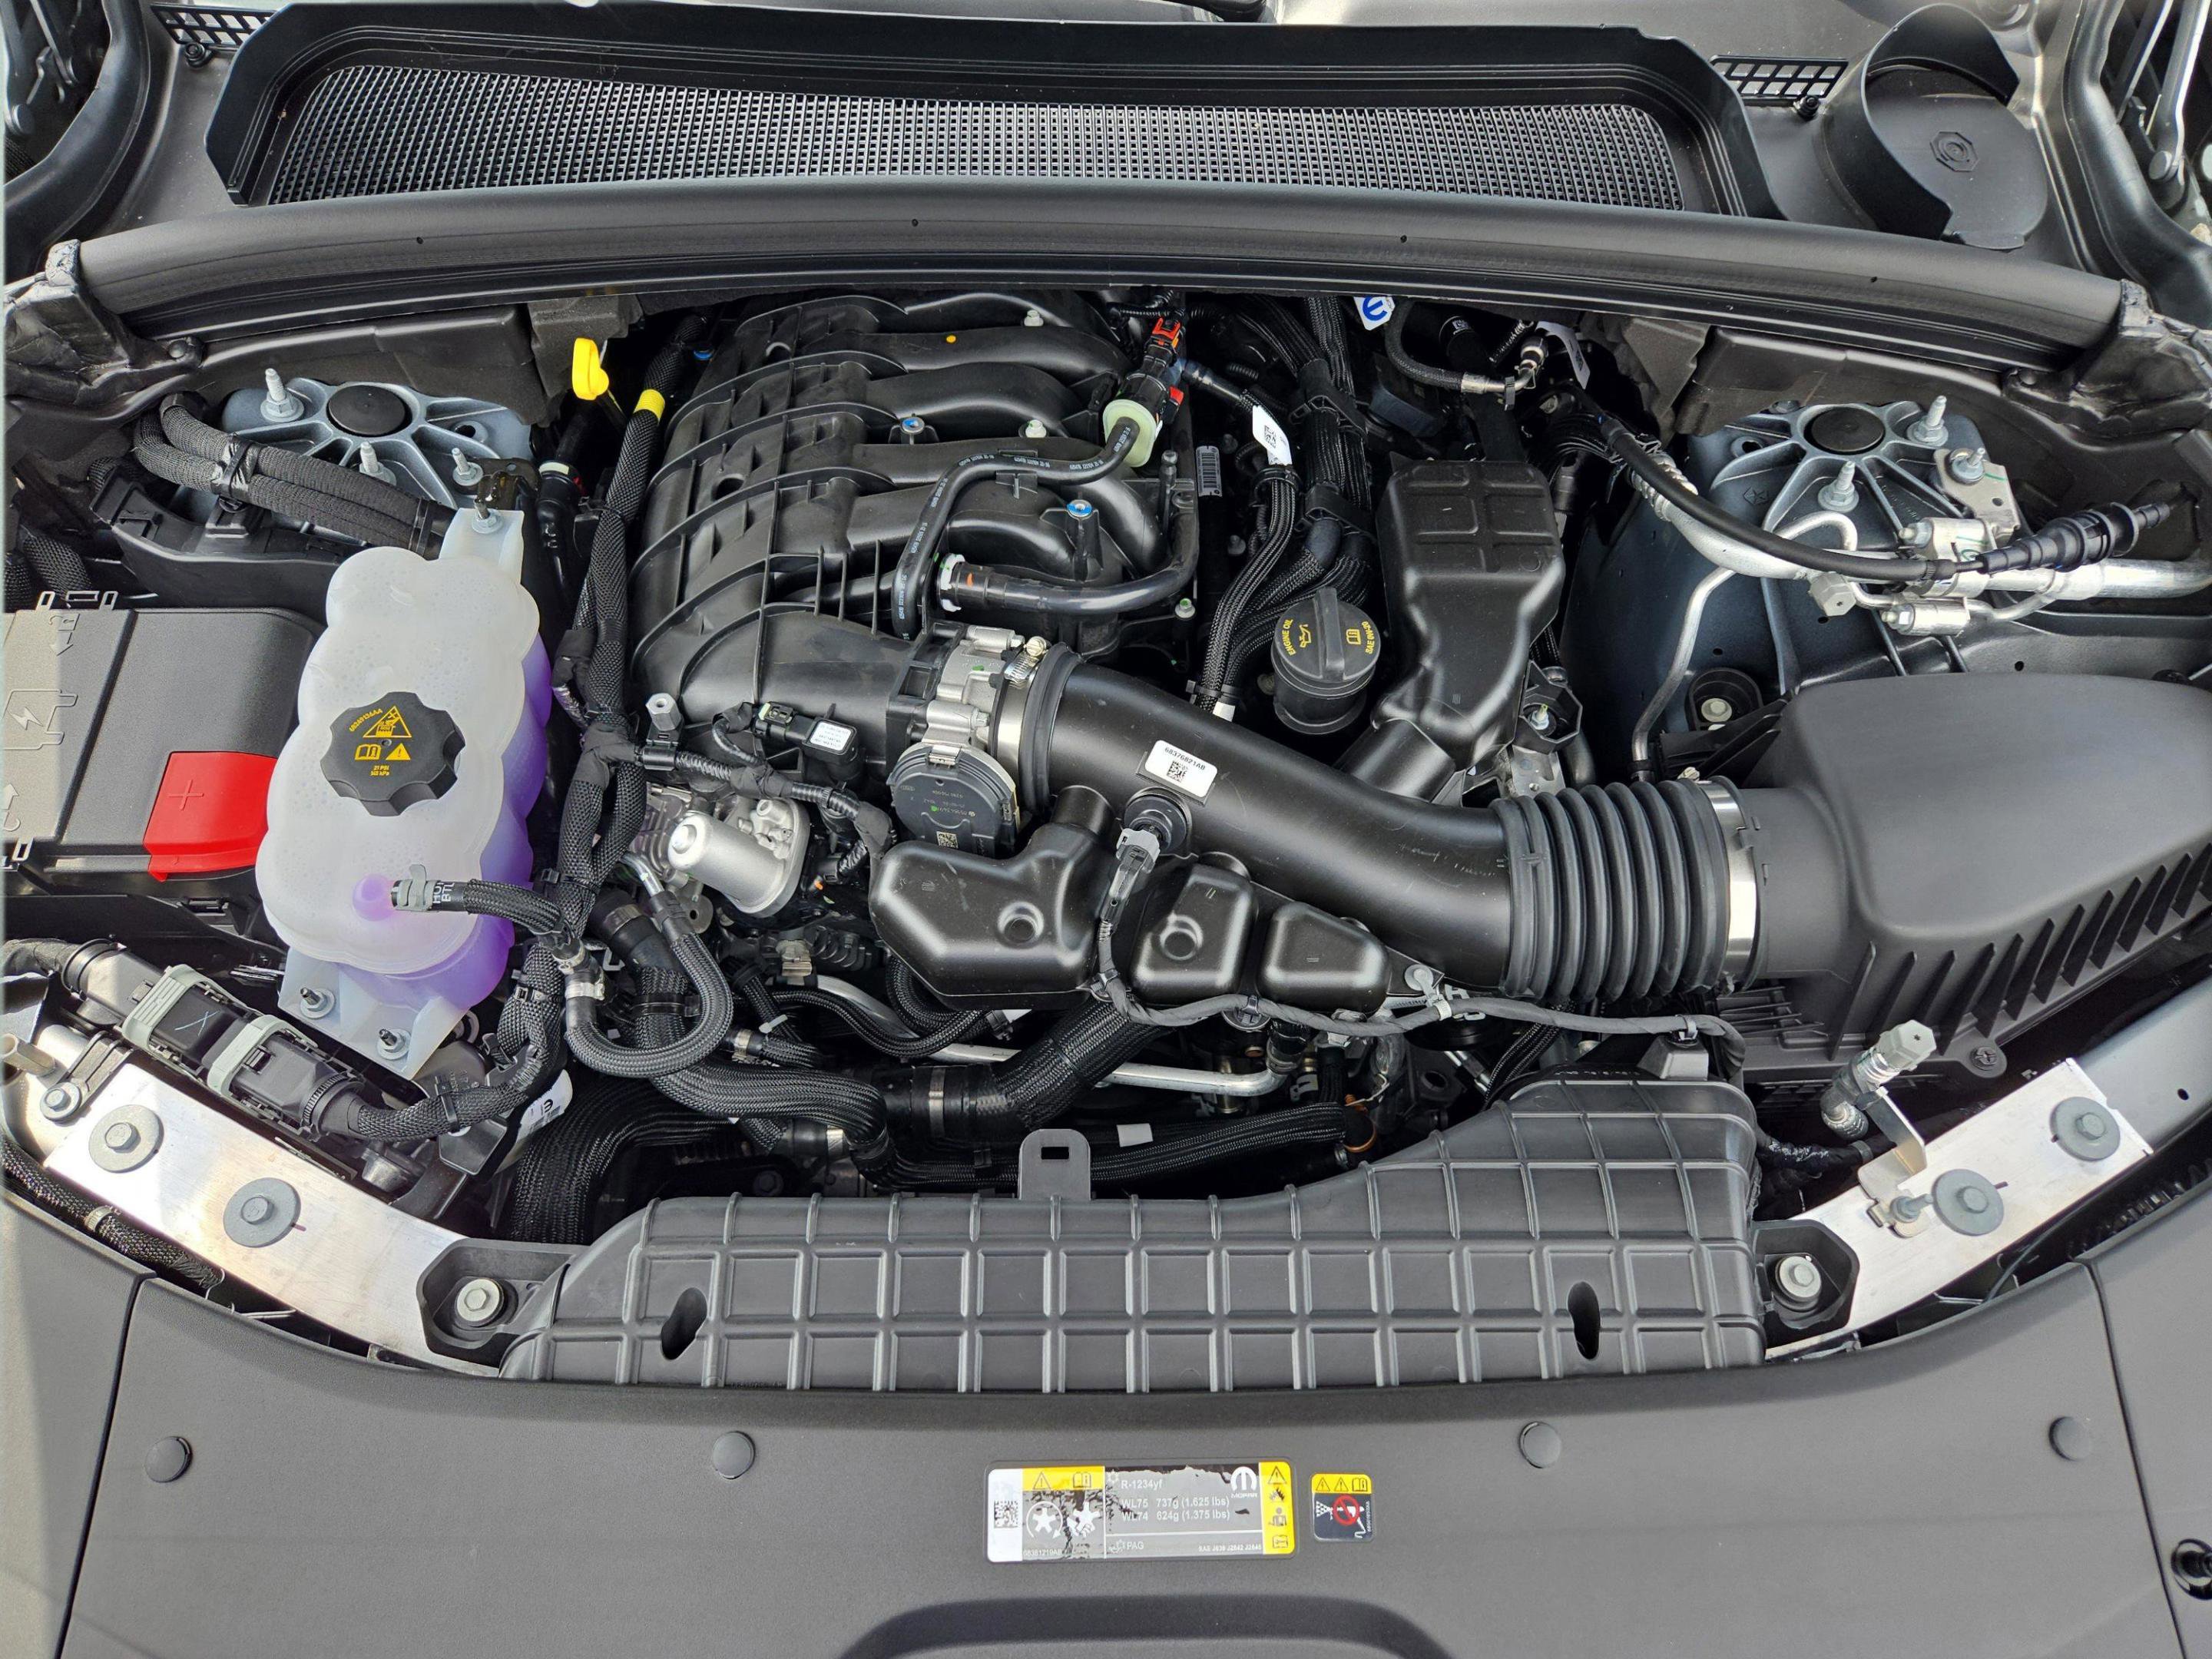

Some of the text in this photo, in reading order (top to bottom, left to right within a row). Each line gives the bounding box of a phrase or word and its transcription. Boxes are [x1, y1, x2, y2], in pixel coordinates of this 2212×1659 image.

[1282, 619, 1296, 656] ENGINE OIL
[1365, 641, 1376, 654] SAE
[432, 882, 443, 904] HO
[442, 882, 455, 902] BTL
[1121, 1479, 1163, 1491] R-1234yf
[1122, 1496, 1230, 1509] WL75 737g (1.625 lbs)
[1122, 1509, 1230, 1522] WL74 624g (1.375 lbs)
[1126, 1541, 1144, 1550] PAG
